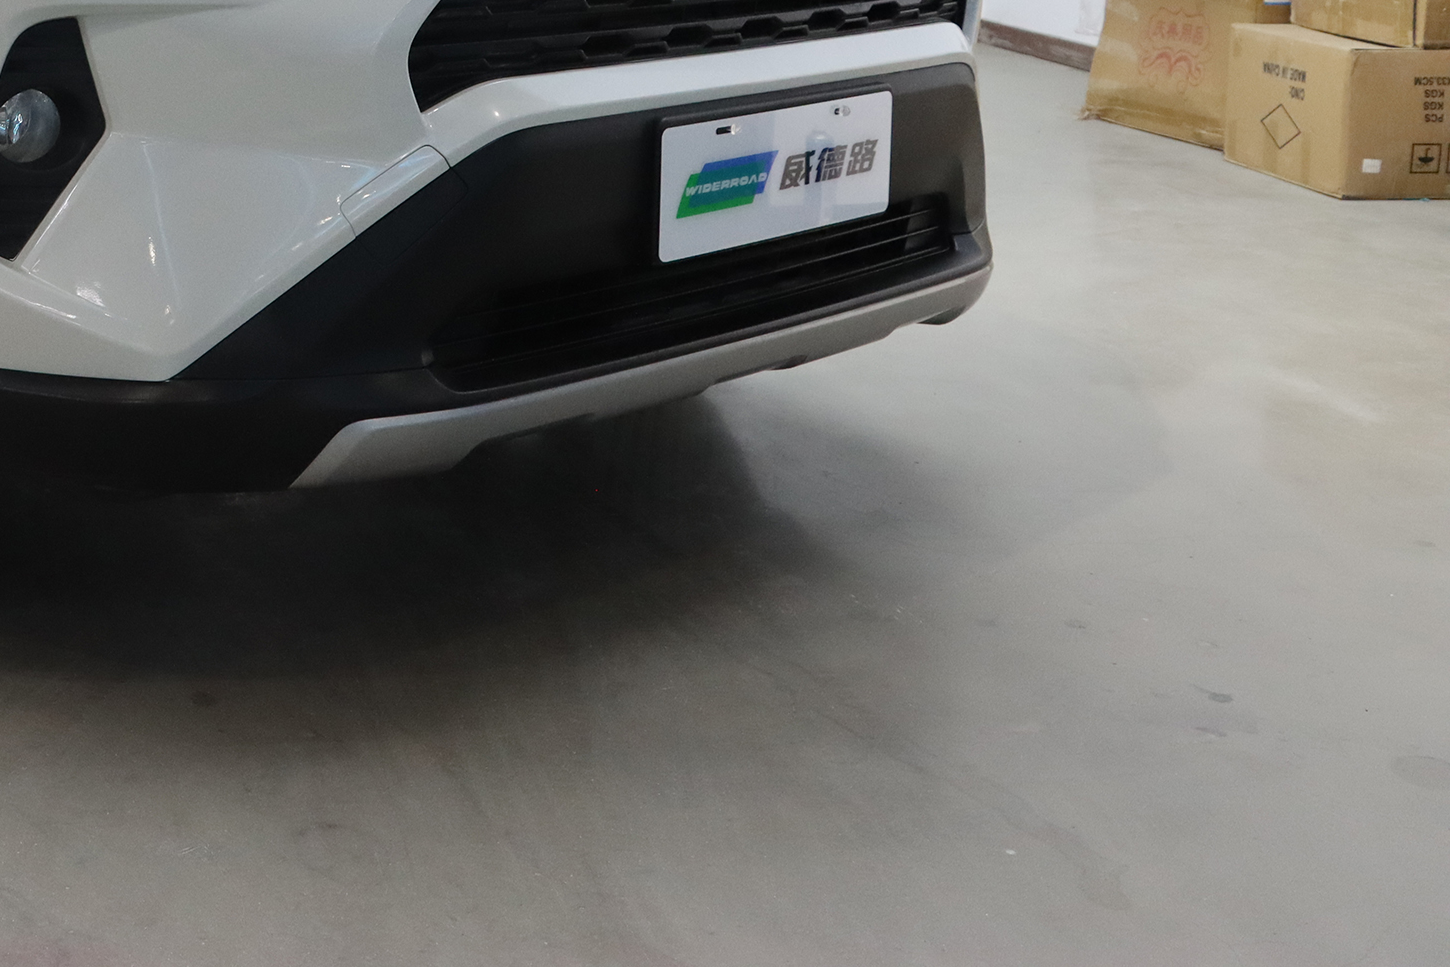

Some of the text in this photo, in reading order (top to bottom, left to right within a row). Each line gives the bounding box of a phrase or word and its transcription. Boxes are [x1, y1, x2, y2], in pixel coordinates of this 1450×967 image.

[1424, 89, 1445, 99] KGS
[1423, 101, 1444, 111] KGS
[1424, 113, 1444, 123] PCS
[685, 139, 879, 196] WIDERROAD 威德路
